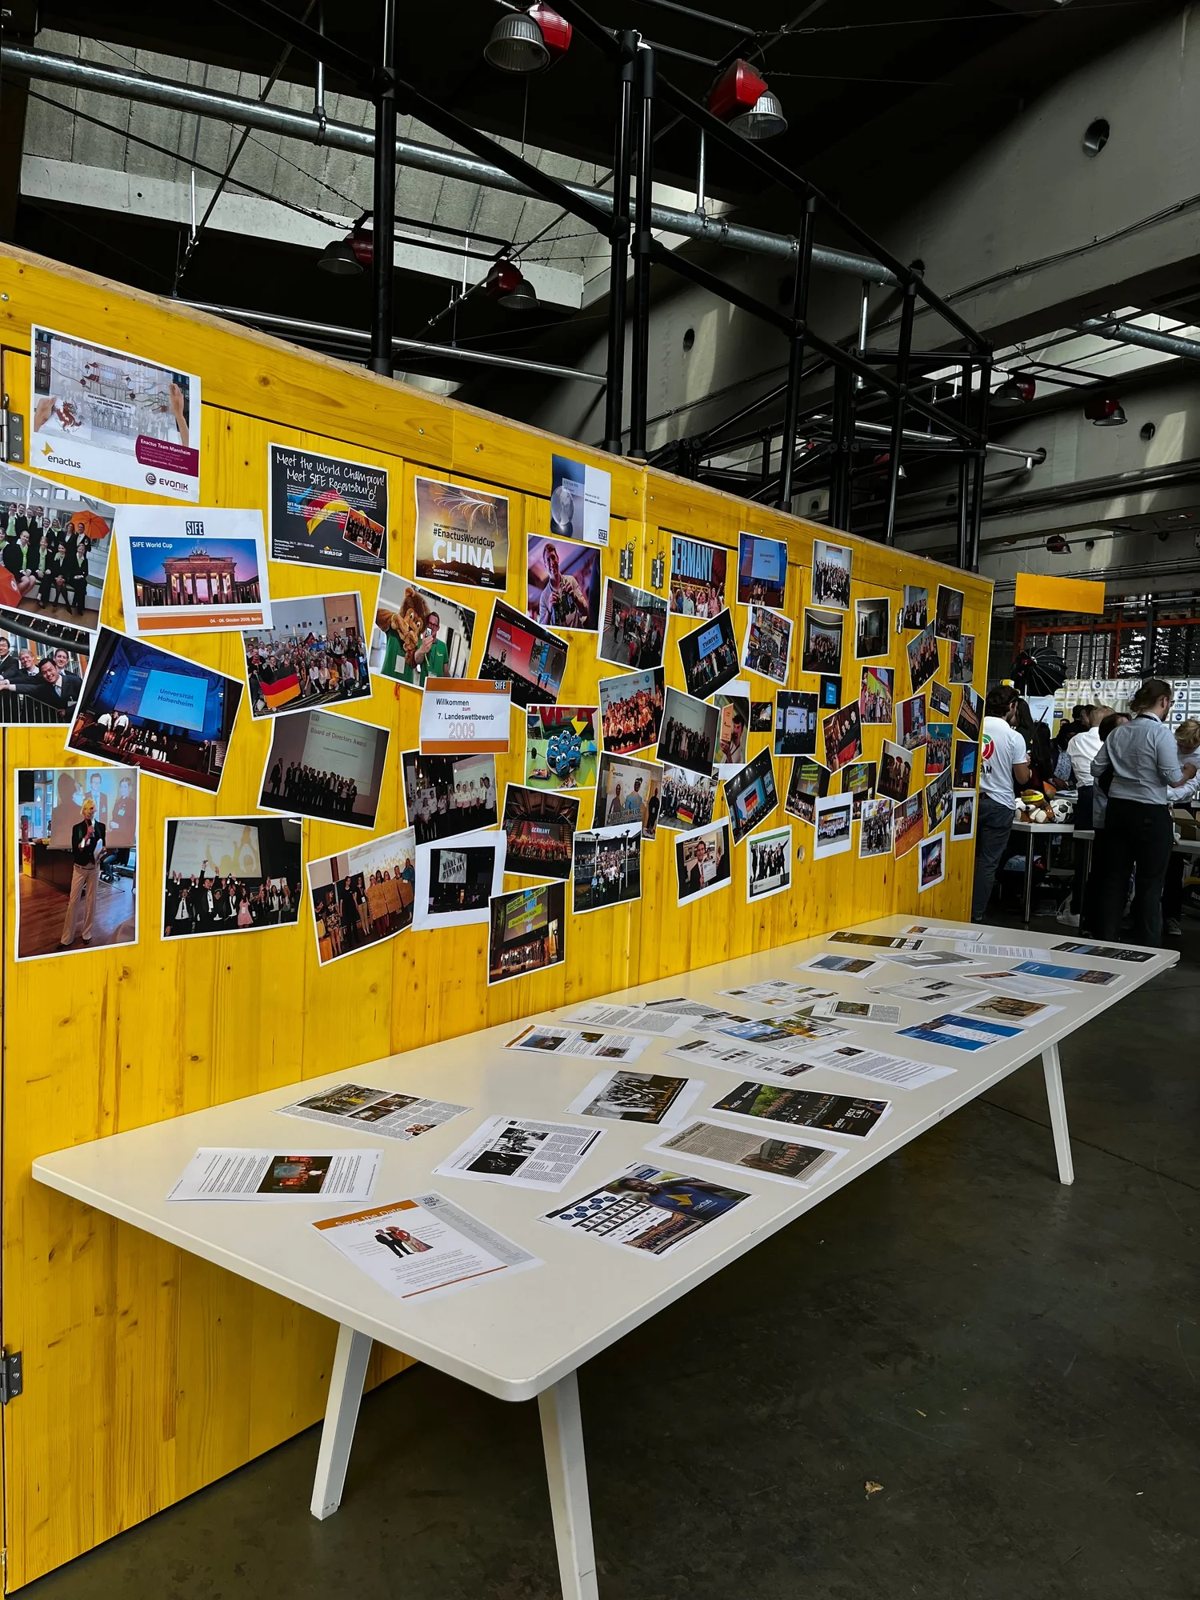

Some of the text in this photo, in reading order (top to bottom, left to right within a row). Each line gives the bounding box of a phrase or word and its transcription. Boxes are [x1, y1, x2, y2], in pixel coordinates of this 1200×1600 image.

[48, 455, 81, 469] enactus
[276, 452, 385, 487] Meet the World Champion!
[286, 468, 307, 482] Meet
[309, 473, 326, 488] SIFE
[329, 477, 377, 501] Regensburg!
[186, 522, 204, 535] SIFE
[433, 527, 496, 549] #EnactusWorldCup
[432, 540, 495, 574] CHINA
[495, 681, 507, 690] SIFE
[157, 695, 194, 708] Hohenheim
[436, 698, 470, 706] Willkommen
[444, 713, 495, 721] Landeswettbewerb
[448, 722, 476, 740] 2009
[335, 1218, 359, 1227] Save
[361, 1213, 378, 1221] the
[379, 1207, 403, 1217] Date
